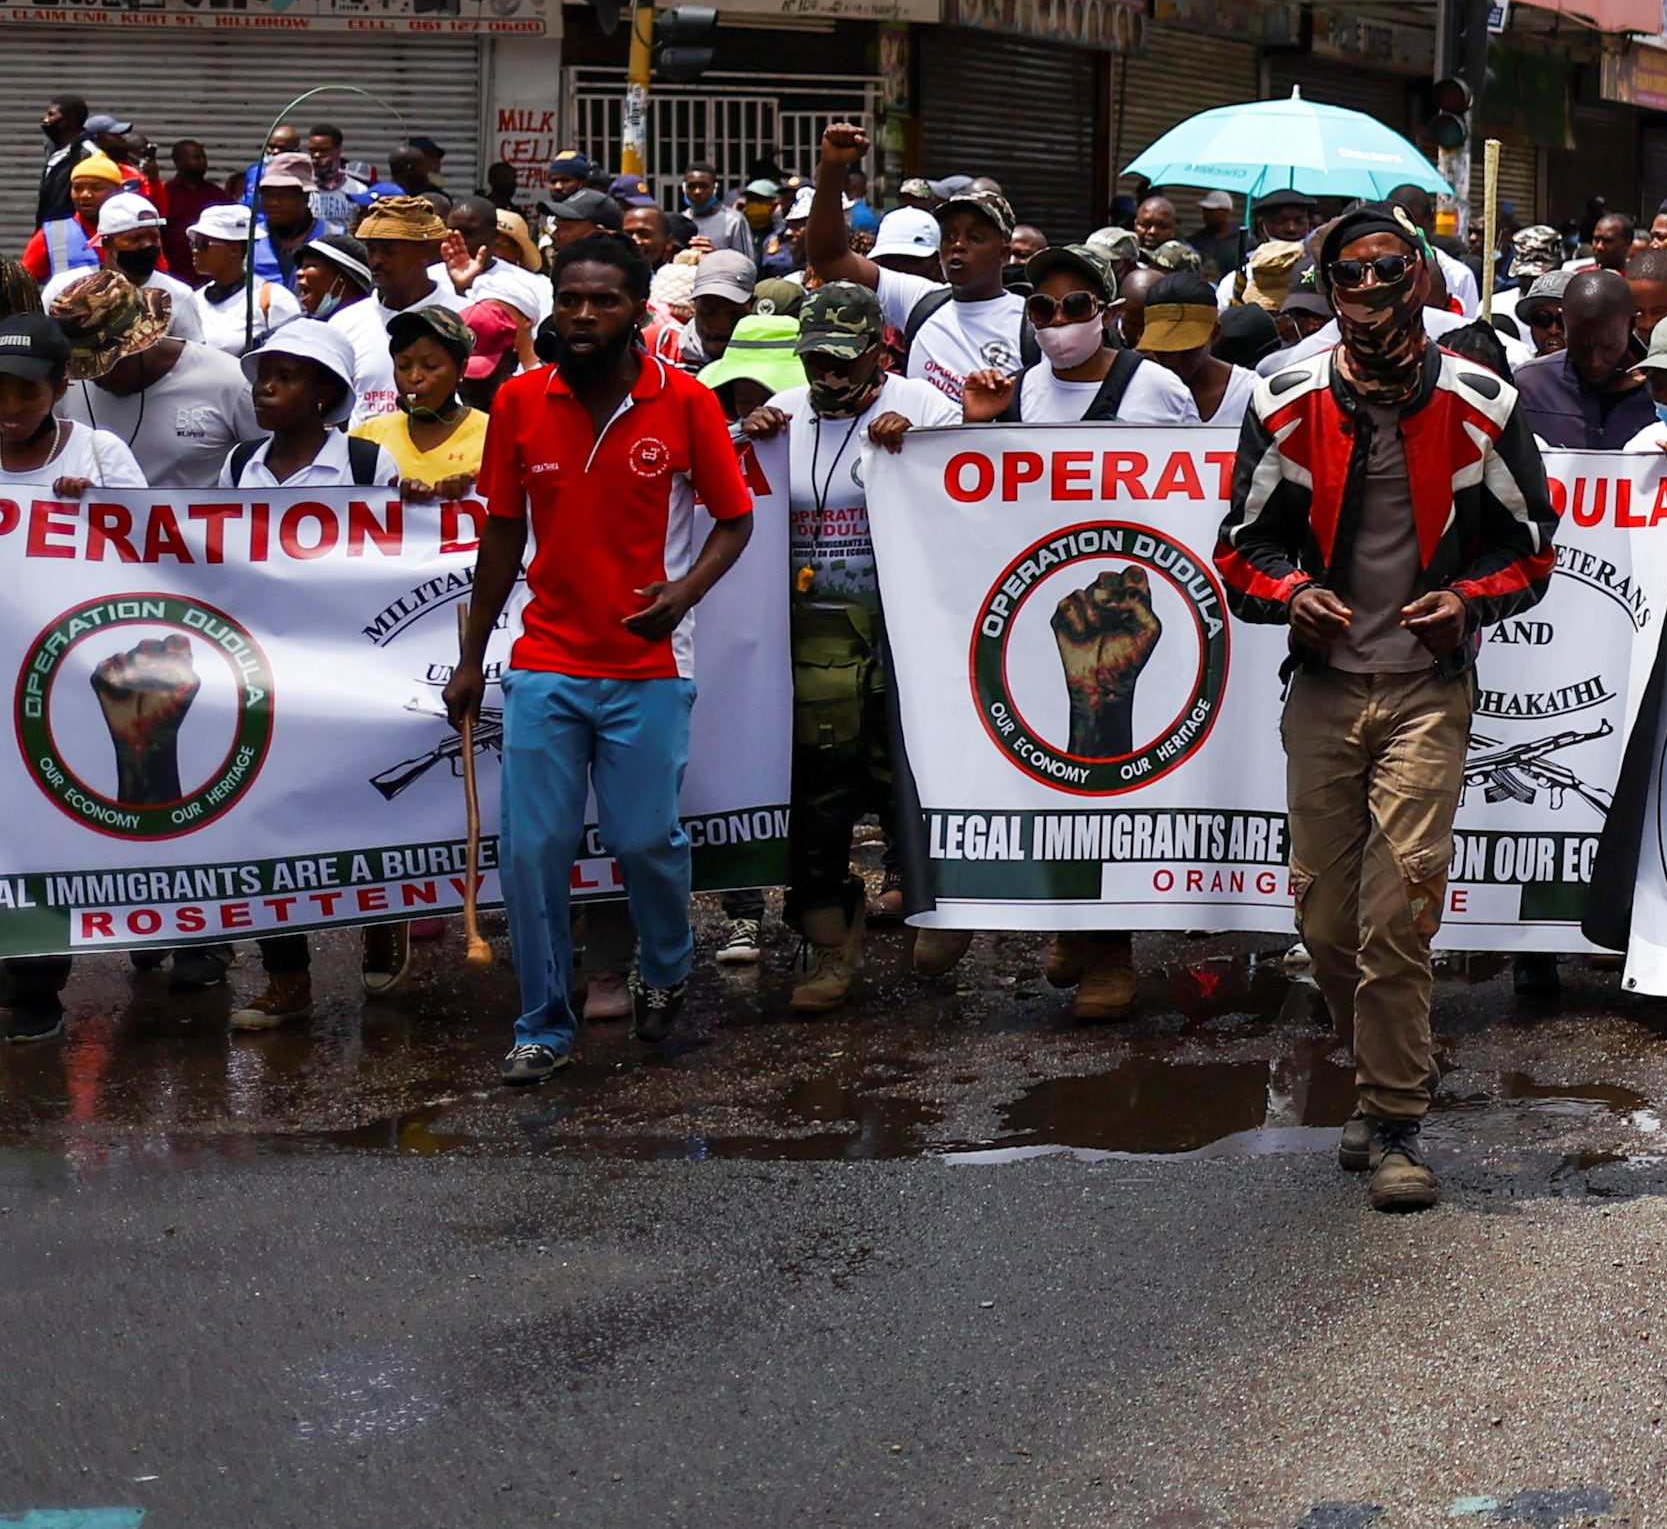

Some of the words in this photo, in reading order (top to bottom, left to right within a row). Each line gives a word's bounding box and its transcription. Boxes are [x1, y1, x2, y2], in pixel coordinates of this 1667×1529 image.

[215, 16, 310, 29] HILLBROW
[497, 108, 556, 134] MILK
[980, 529, 1127, 641] OPERATION
[1130, 536, 1226, 641] DUDULA
[23, 598, 166, 720] OPERATION
[182, 606, 266, 709] DUDULA
[1488, 620, 1555, 646] AND
[989, 701, 1017, 735] OUR
[1011, 731, 1092, 784] ECONOMY
[1118, 755, 1155, 780] OUR
[1153, 698, 1213, 769] HERITAGE
[37, 754, 67, 791] OUR
[64, 784, 141, 830] ECONOMY
[170, 797, 205, 825] OUR
[203, 742, 256, 810] HERITAGE
[45, 865, 260, 907] IMMIGRANTS
[271, 858, 339, 894] ARE
[350, 854, 372, 885] A
[1032, 813, 1225, 863] IMMIGRANTS
[1228, 816, 1286, 863] ARE
[1493, 834, 1554, 884] OUR
